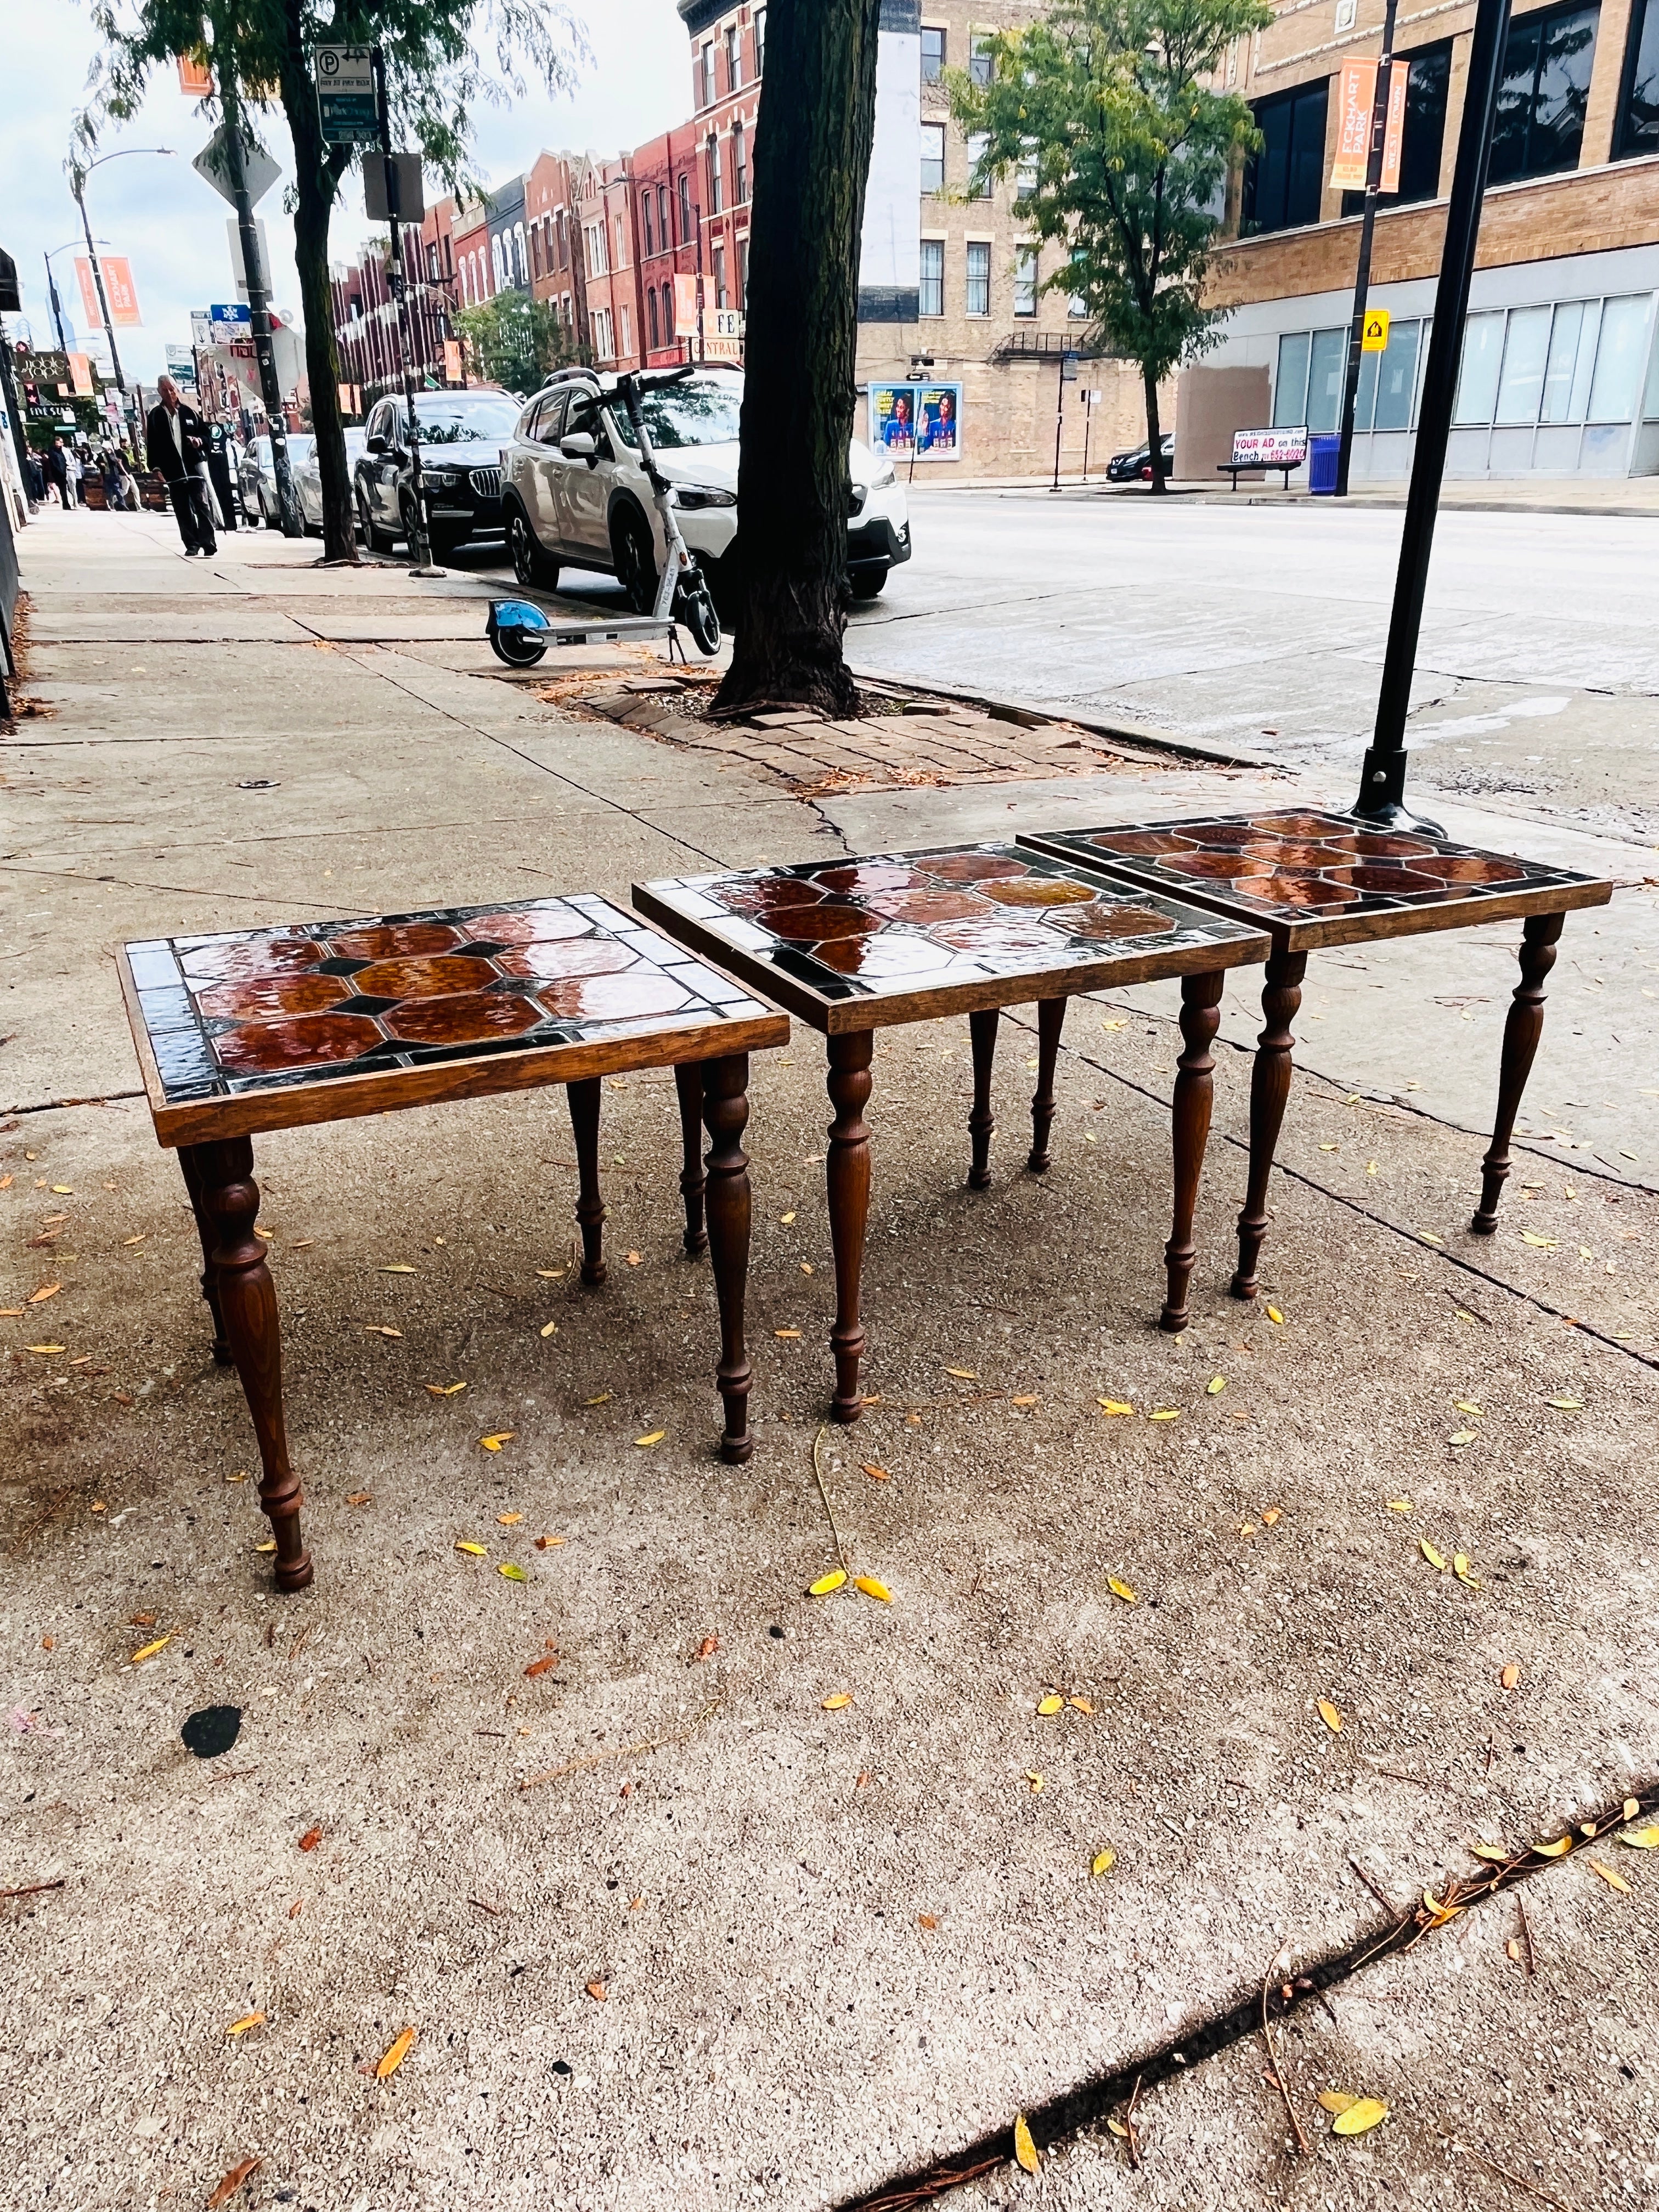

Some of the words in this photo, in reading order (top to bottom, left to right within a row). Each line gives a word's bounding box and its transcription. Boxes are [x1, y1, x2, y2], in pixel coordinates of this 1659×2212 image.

[1342, 70, 1360, 154] ECKHART
[1391, 86, 1402, 124] TOWN
[1352, 109, 1368, 154] PARK
[1387, 134, 1398, 170] WEST
[121, 284, 132, 307] PARK
[694, 341, 738, 356] CNTRAL
[30, 407, 48, 416] FIVE
[1235, 439, 1259, 449] YOUR
[1262, 438, 1274, 448] AD
[1291, 437, 1306, 447] this
[1234, 451, 1259, 462] Bench
